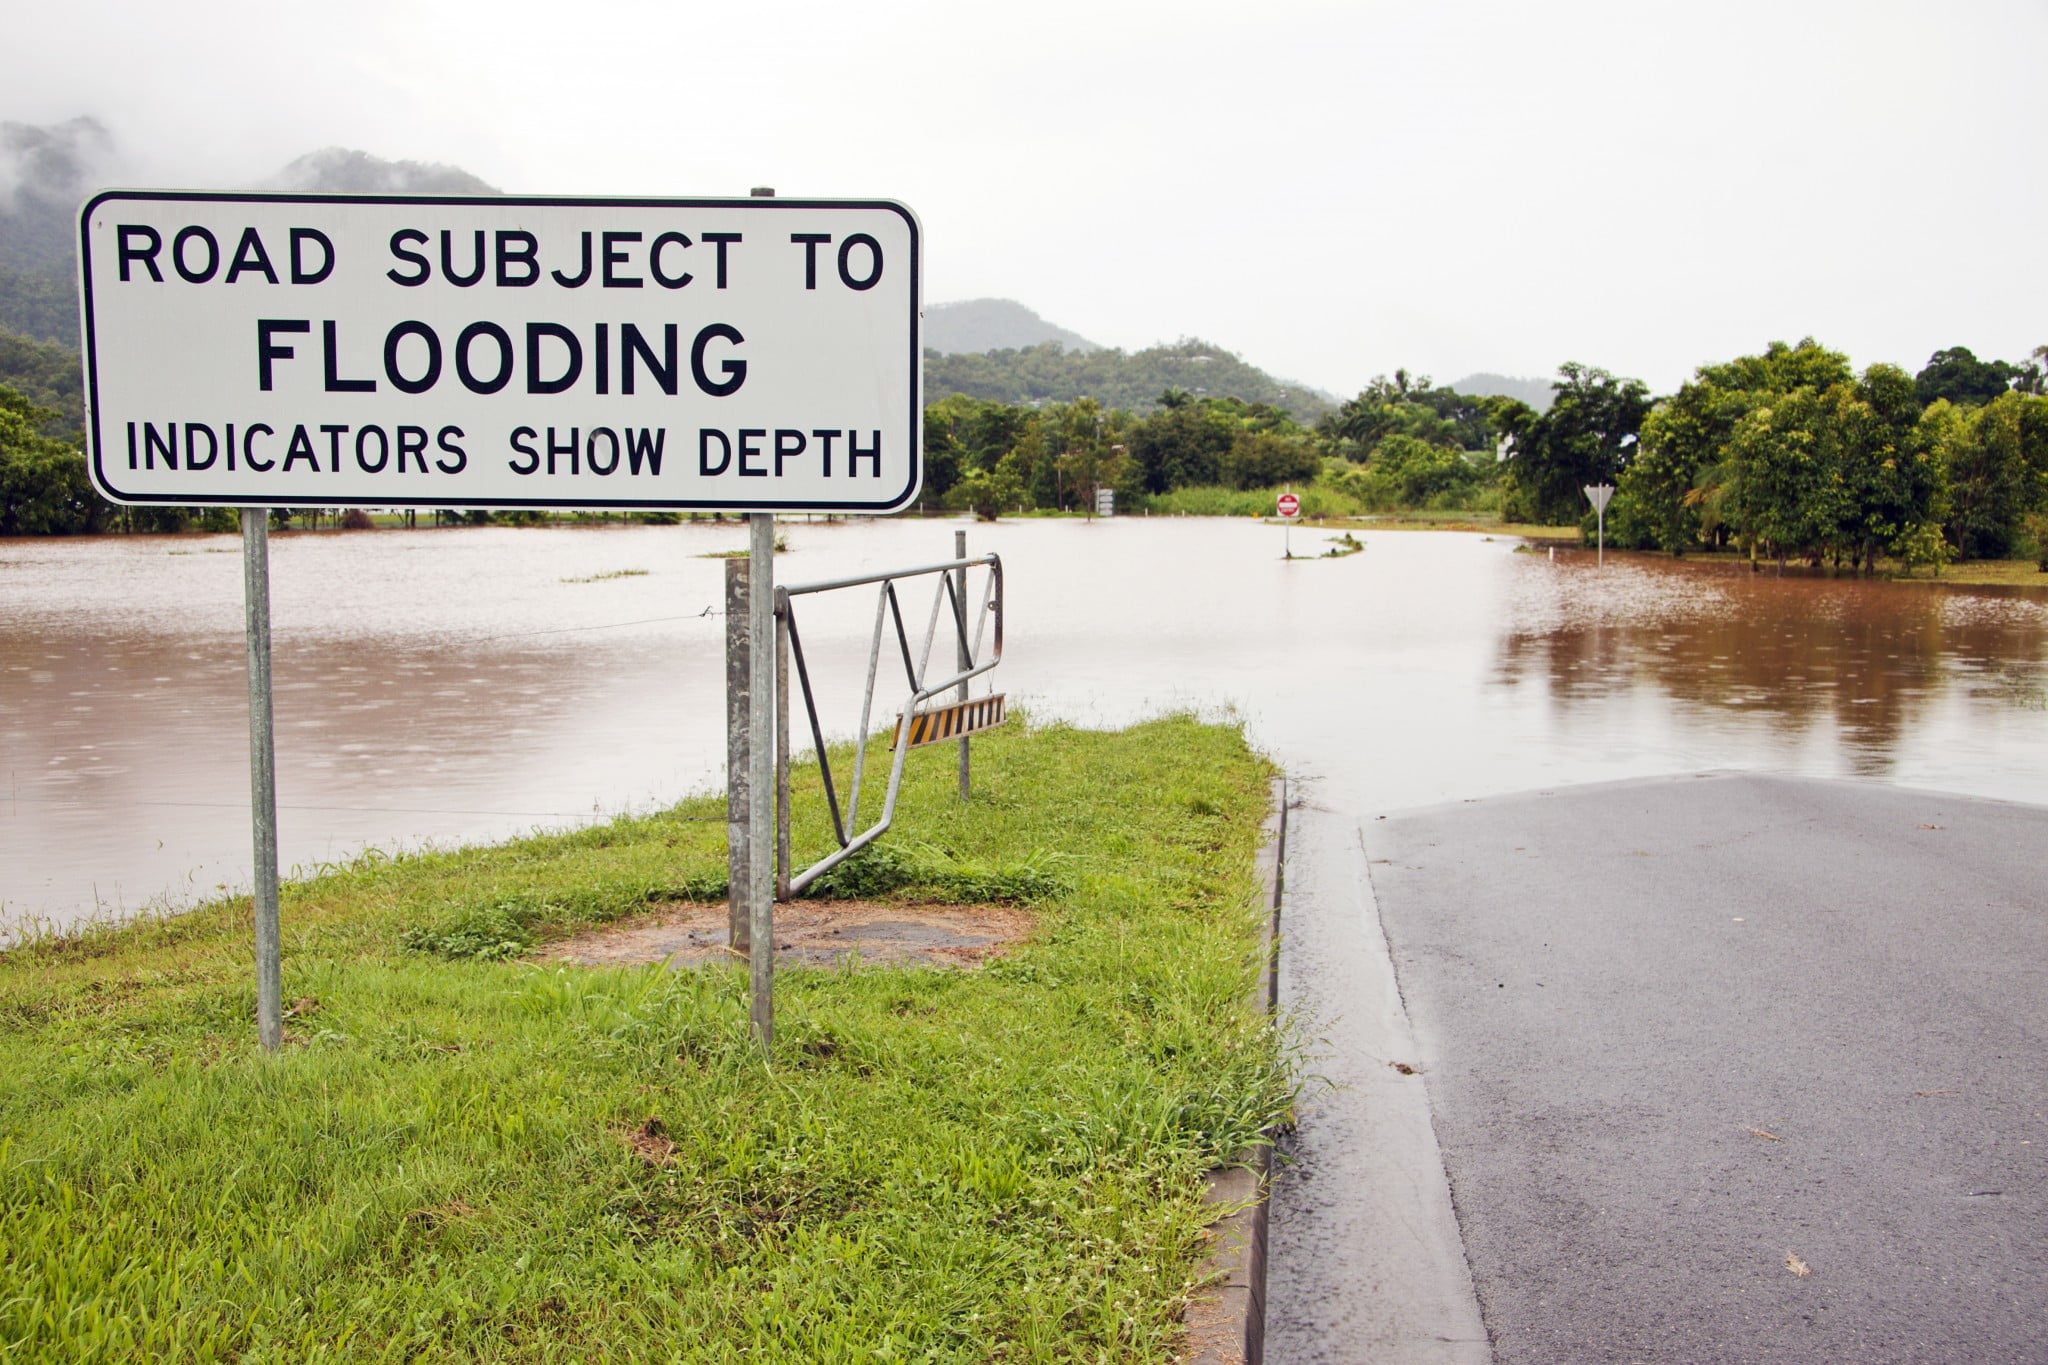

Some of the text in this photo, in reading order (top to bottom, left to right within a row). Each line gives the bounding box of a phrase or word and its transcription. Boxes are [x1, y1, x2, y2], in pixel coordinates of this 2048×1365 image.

[117, 225, 883, 290] ROAD SUBJECT TO
[258, 319, 746, 397] FLOODING
[127, 422, 880, 477] INDICATORS SHOW DEPTH
